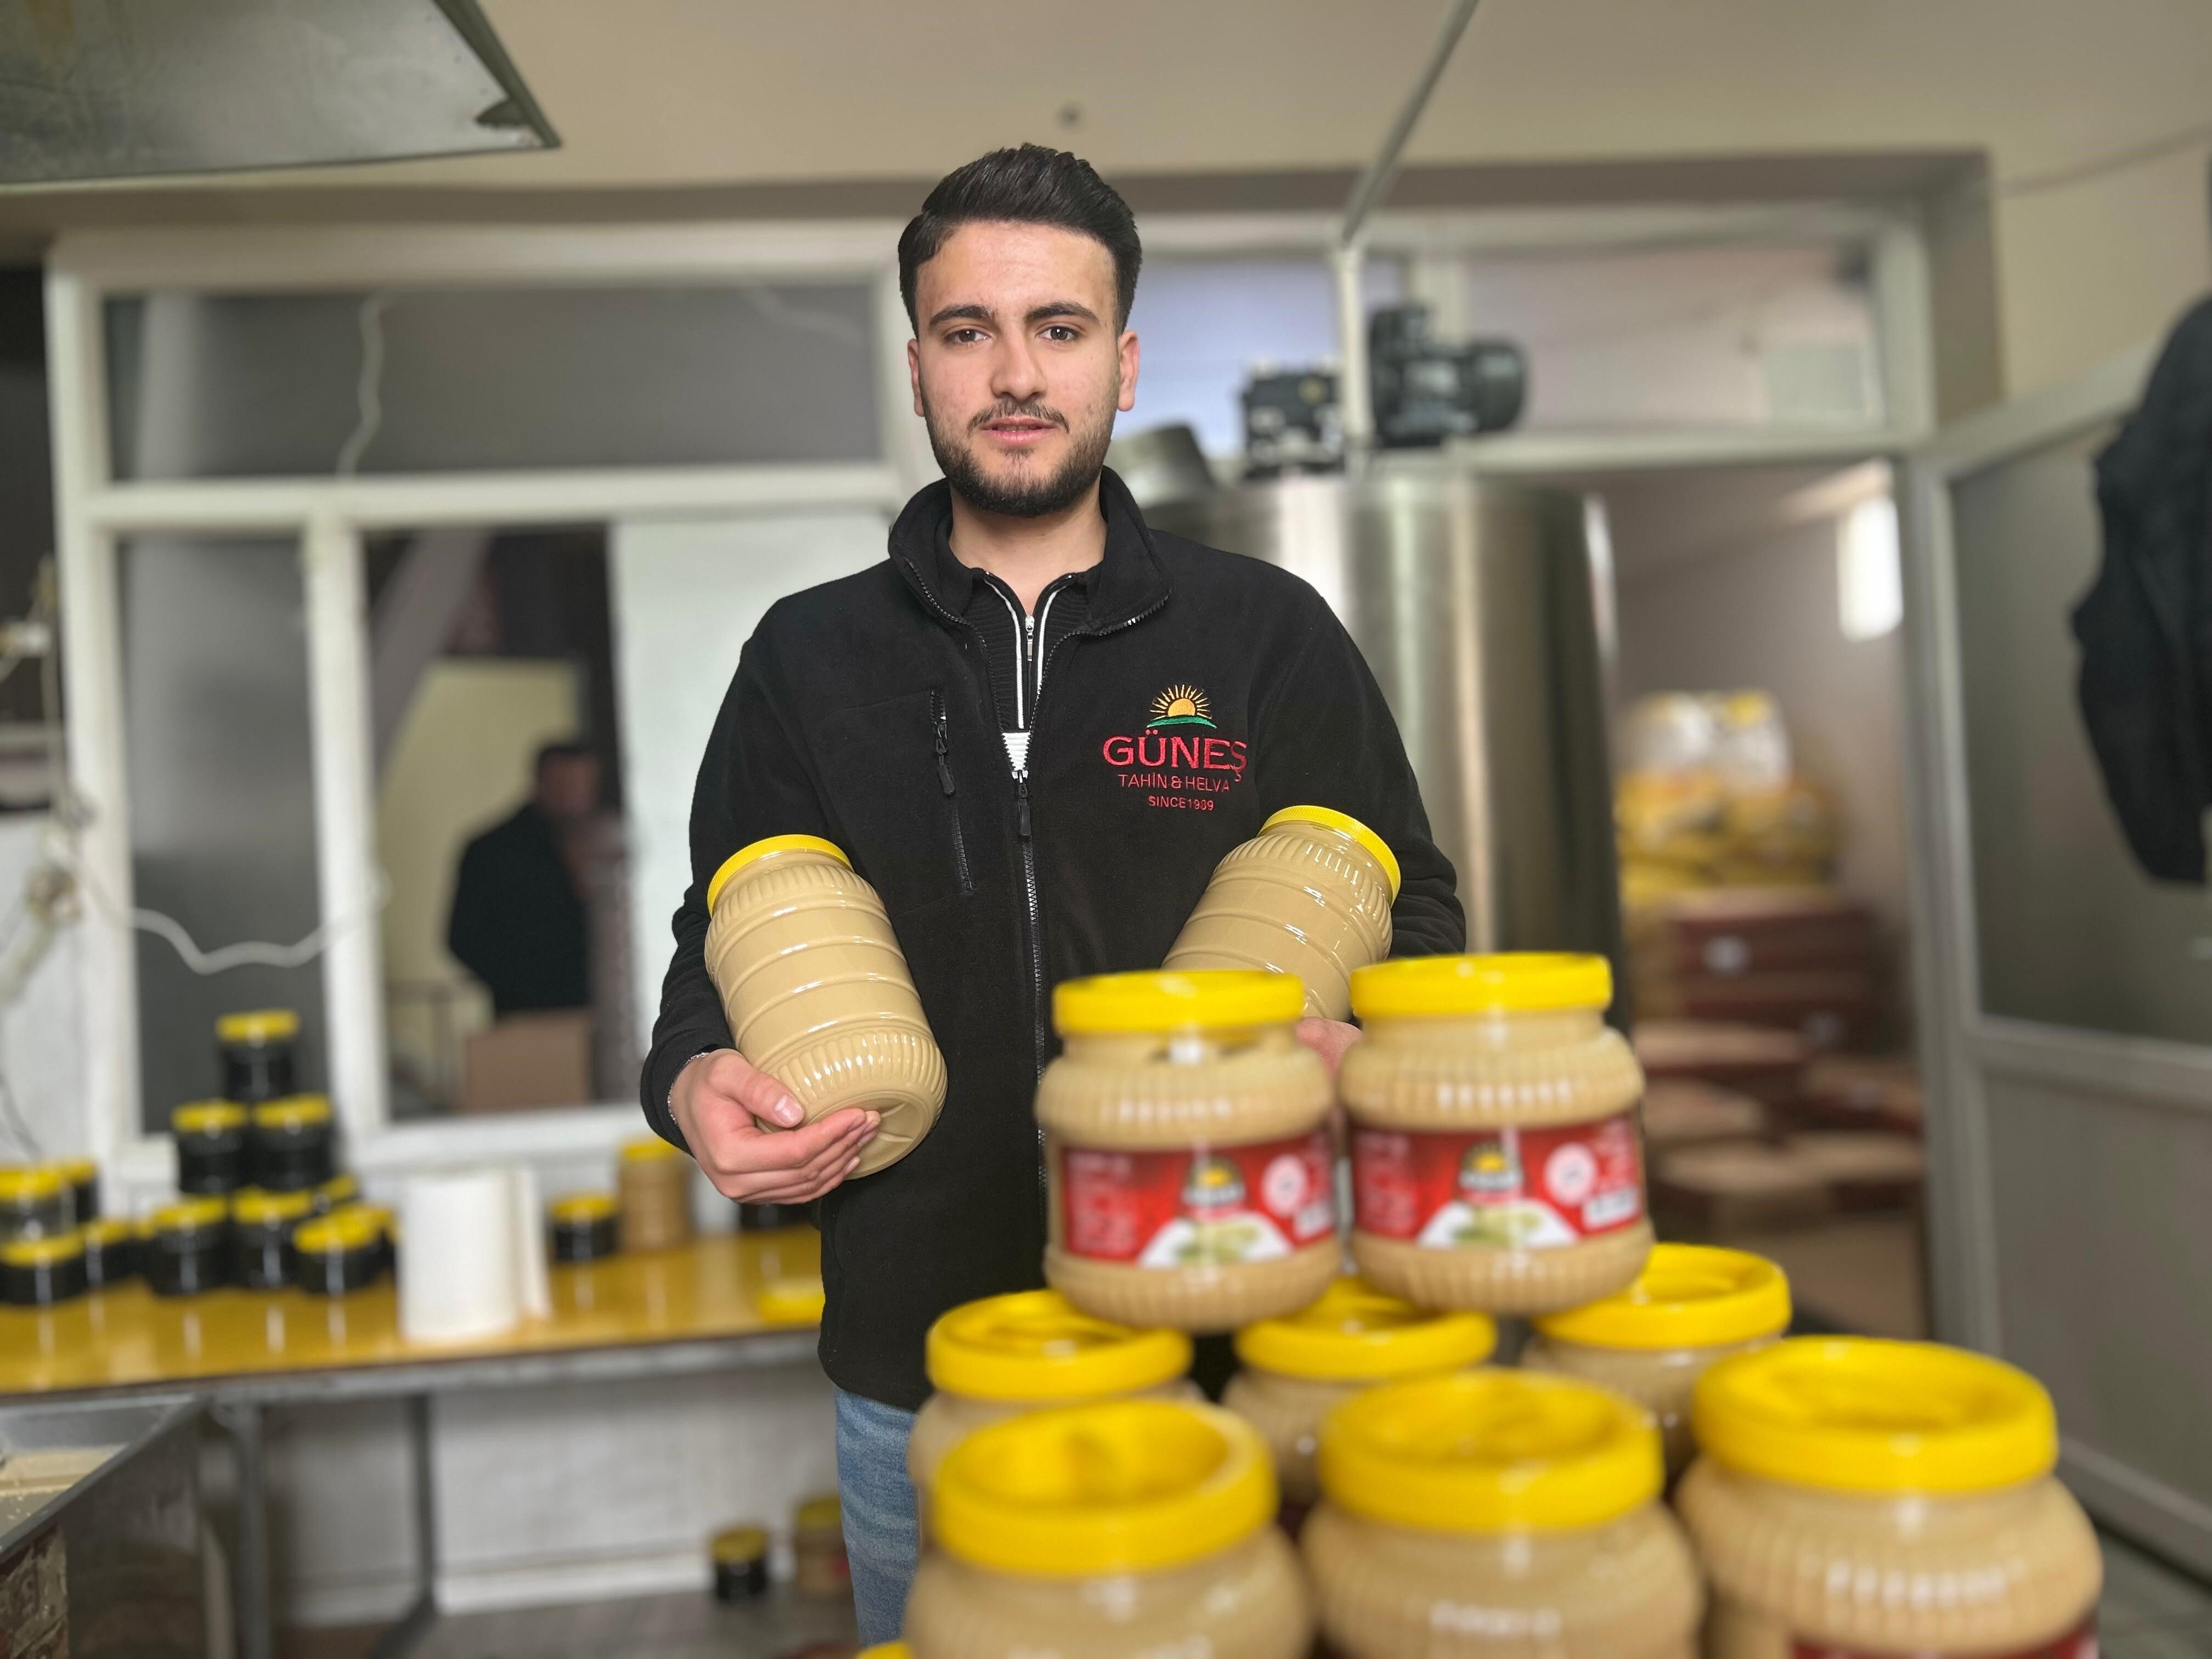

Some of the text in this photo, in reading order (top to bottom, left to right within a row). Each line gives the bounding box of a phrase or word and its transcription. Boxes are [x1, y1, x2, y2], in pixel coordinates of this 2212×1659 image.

[1102, 729, 1247, 782] GÜNEŞ
[1118, 772, 1229, 792] TAHİN & HELVA
